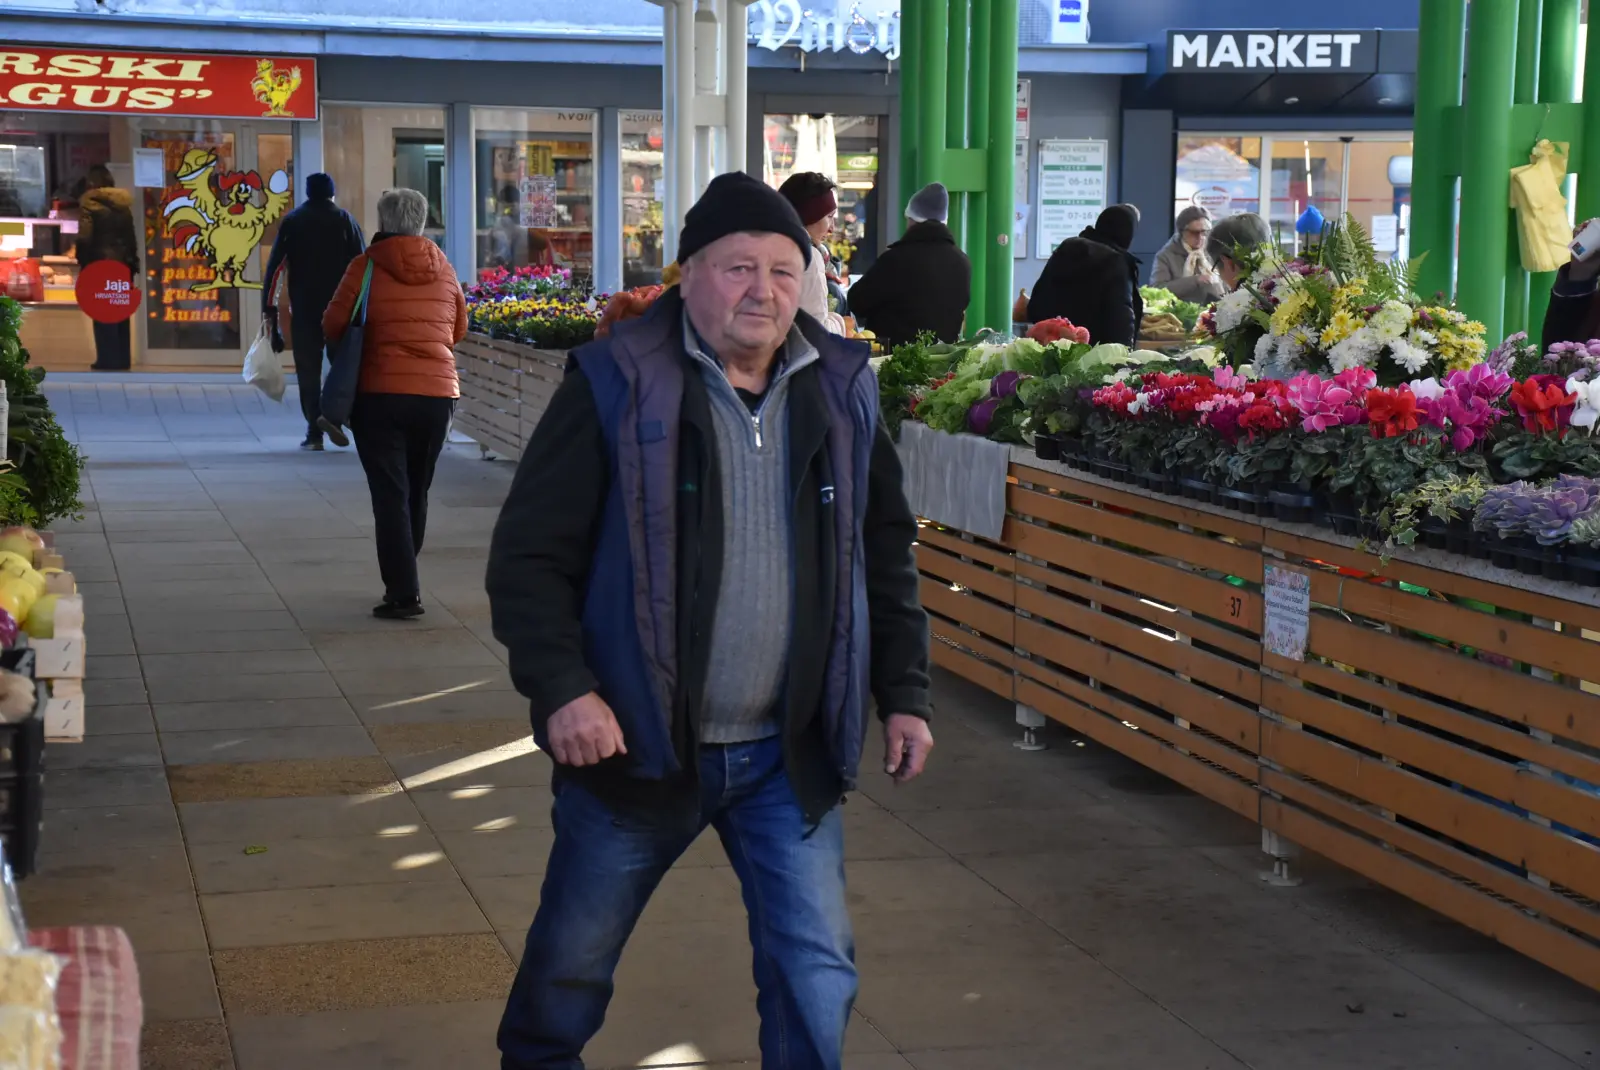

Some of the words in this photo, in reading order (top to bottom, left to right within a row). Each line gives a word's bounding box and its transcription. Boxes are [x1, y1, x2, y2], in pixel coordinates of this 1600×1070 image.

[1173, 34, 1361, 67] MARKET
[0, 51, 211, 82] RSKI
[0, 82, 213, 110] GUS”
[104, 279, 130, 293] Jaja
[163, 305, 231, 322] kunića
[1230, 596, 1242, 618] 37
